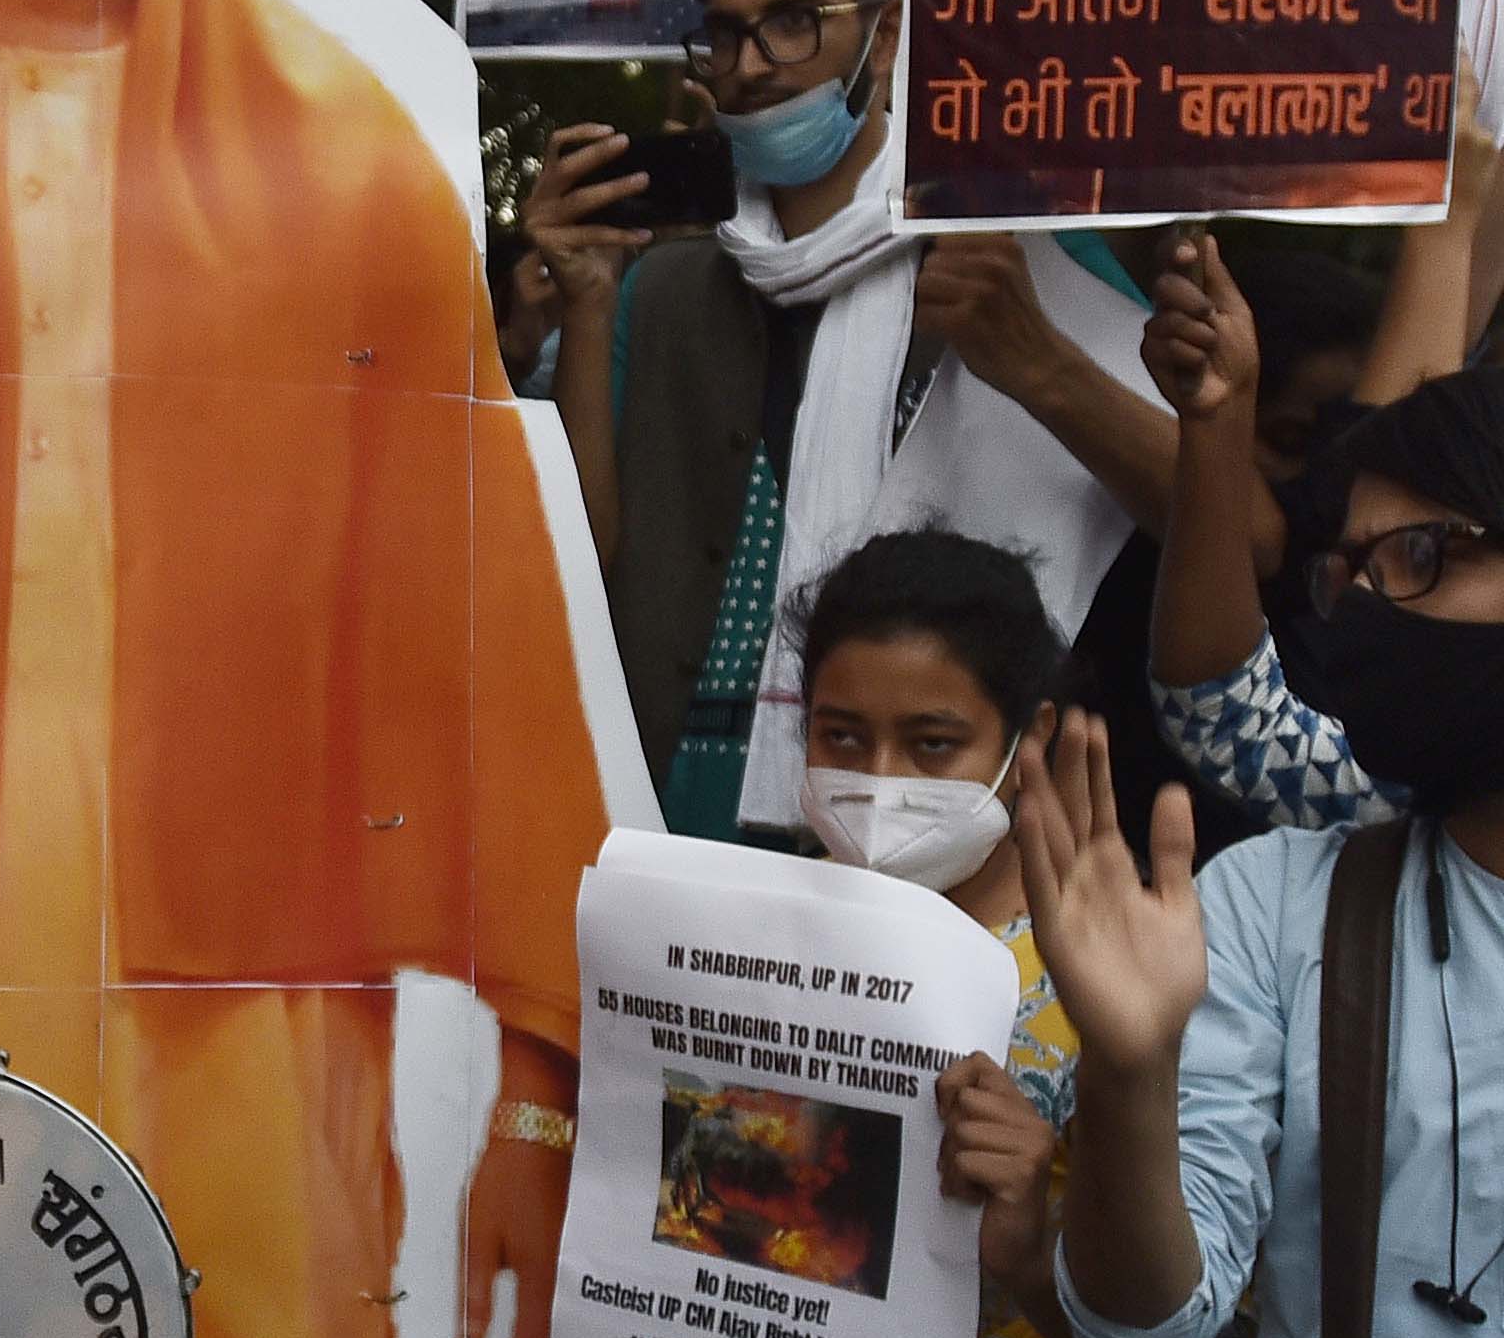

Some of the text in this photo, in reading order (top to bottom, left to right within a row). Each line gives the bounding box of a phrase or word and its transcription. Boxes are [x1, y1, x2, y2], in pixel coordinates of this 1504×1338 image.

[928, 54, 1454, 143] वो भी तो 'बलात्कार' था
[667, 944, 915, 1006] IN SHABBIRPUR, UP IN 2017
[597, 987, 866, 1059] 55 HOUSES BELONGING TO DALIT
[651, 1026, 920, 1100] WAS BURNT DOWN BY THAKURS
[580, 1274, 657, 1317] Casteist
[658, 1294, 683, 1322] UP
[684, 1301, 717, 1332] CM
[695, 1267, 832, 1327] No justice yet!
